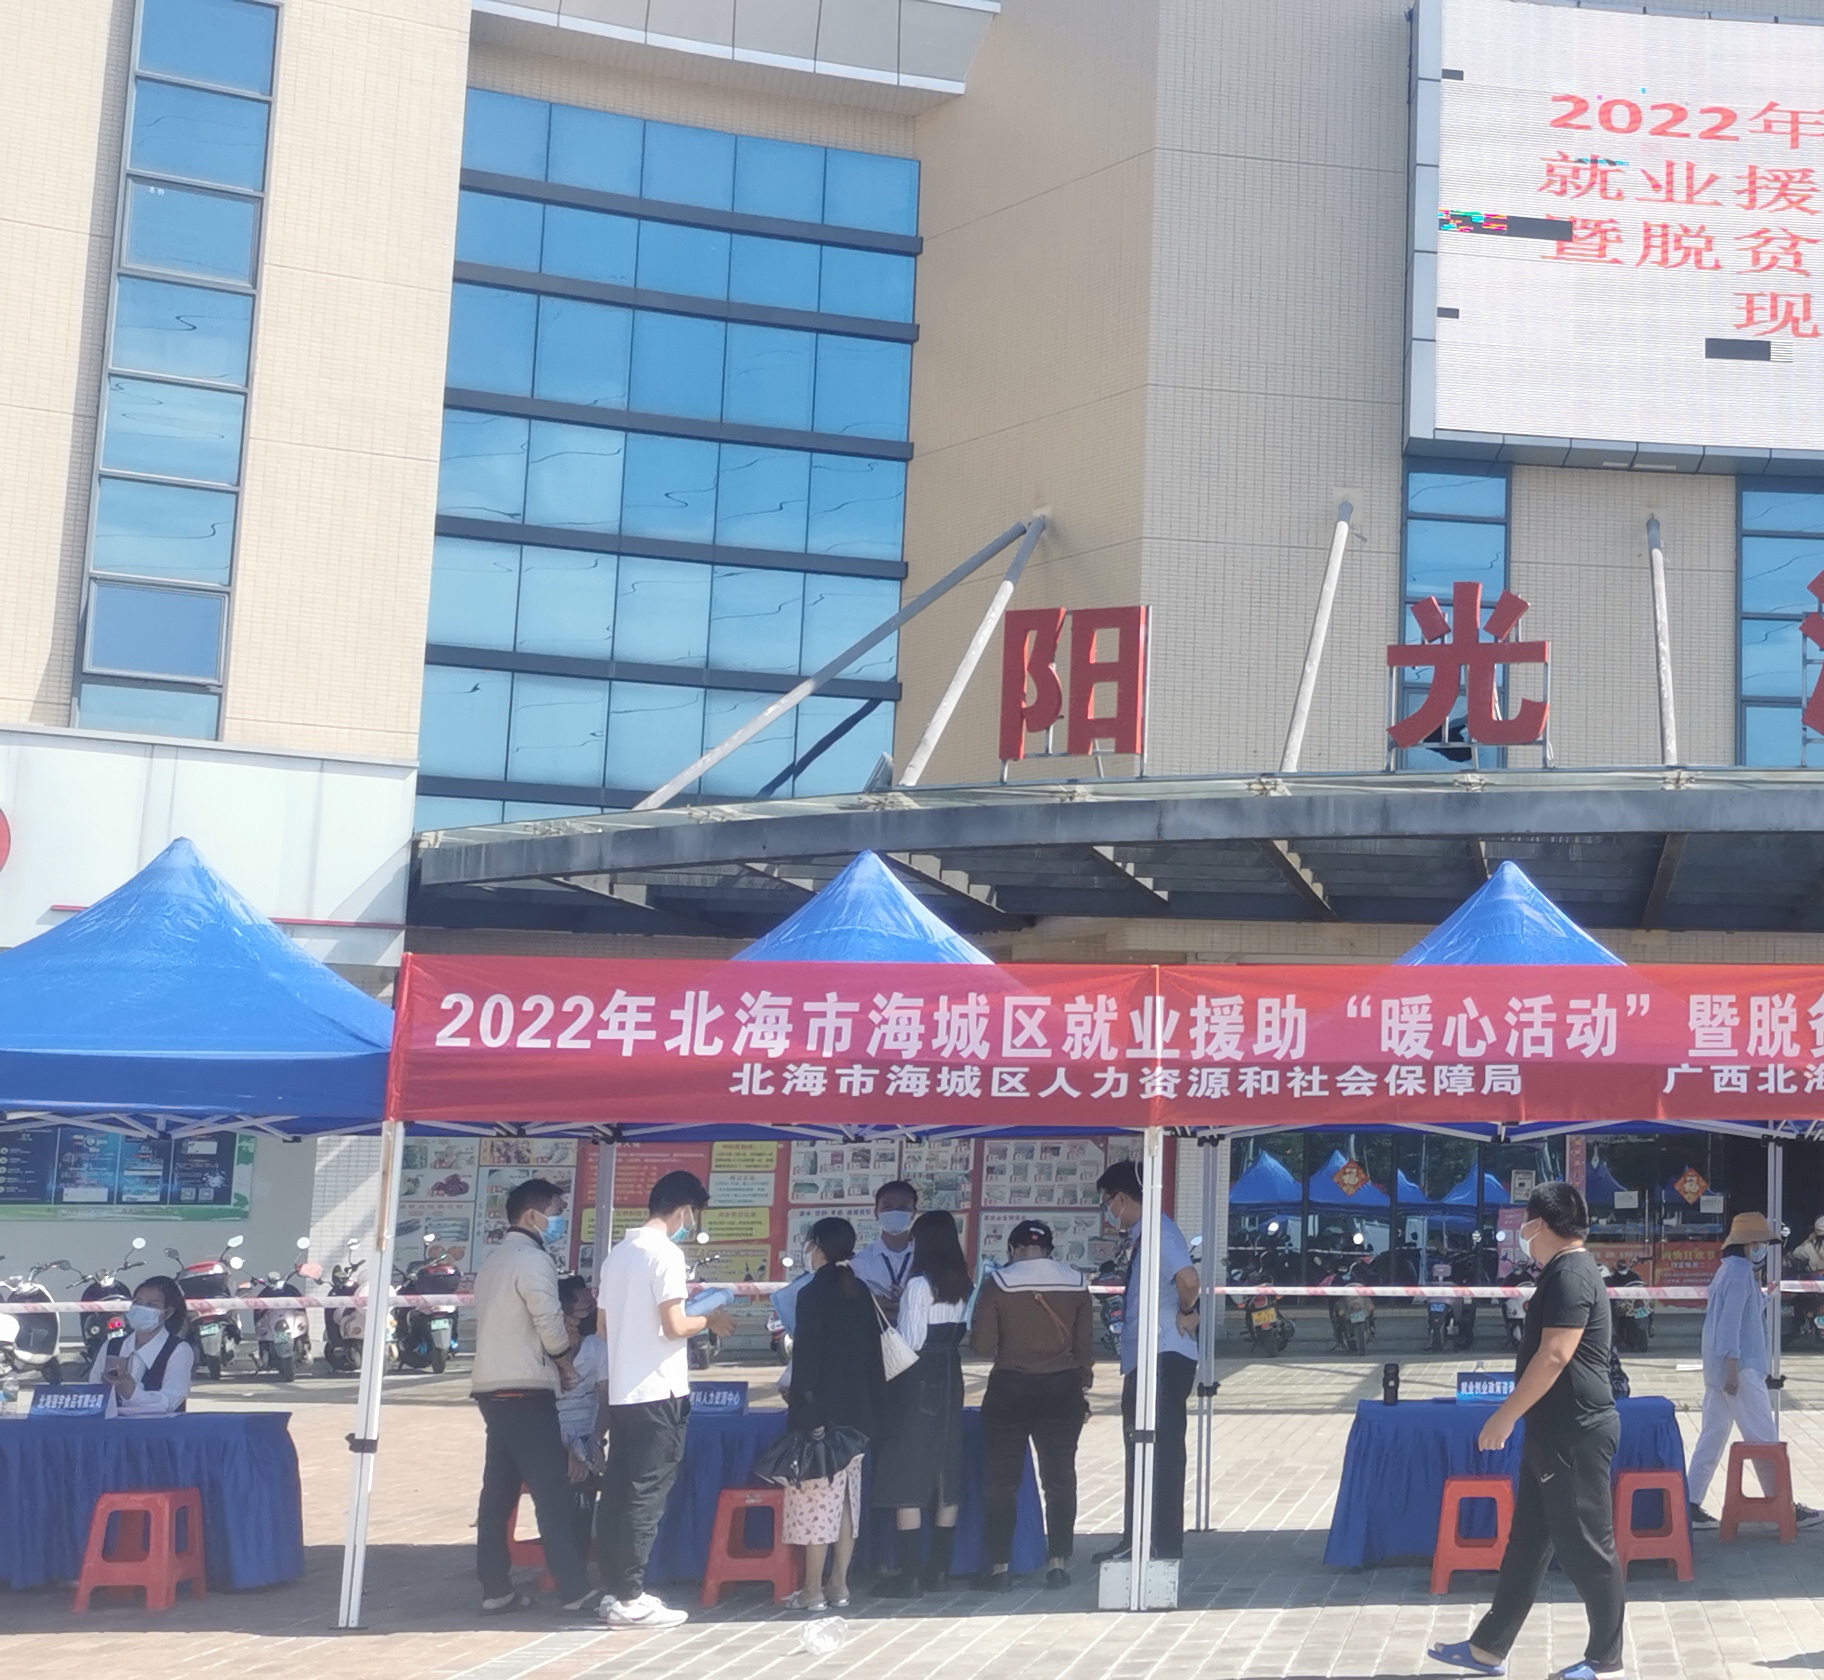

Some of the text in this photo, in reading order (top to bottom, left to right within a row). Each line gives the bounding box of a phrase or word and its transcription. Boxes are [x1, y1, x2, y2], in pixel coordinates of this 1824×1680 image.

[729, 1062, 1523, 1100] 北海市海城区人力资源和社会保障局
